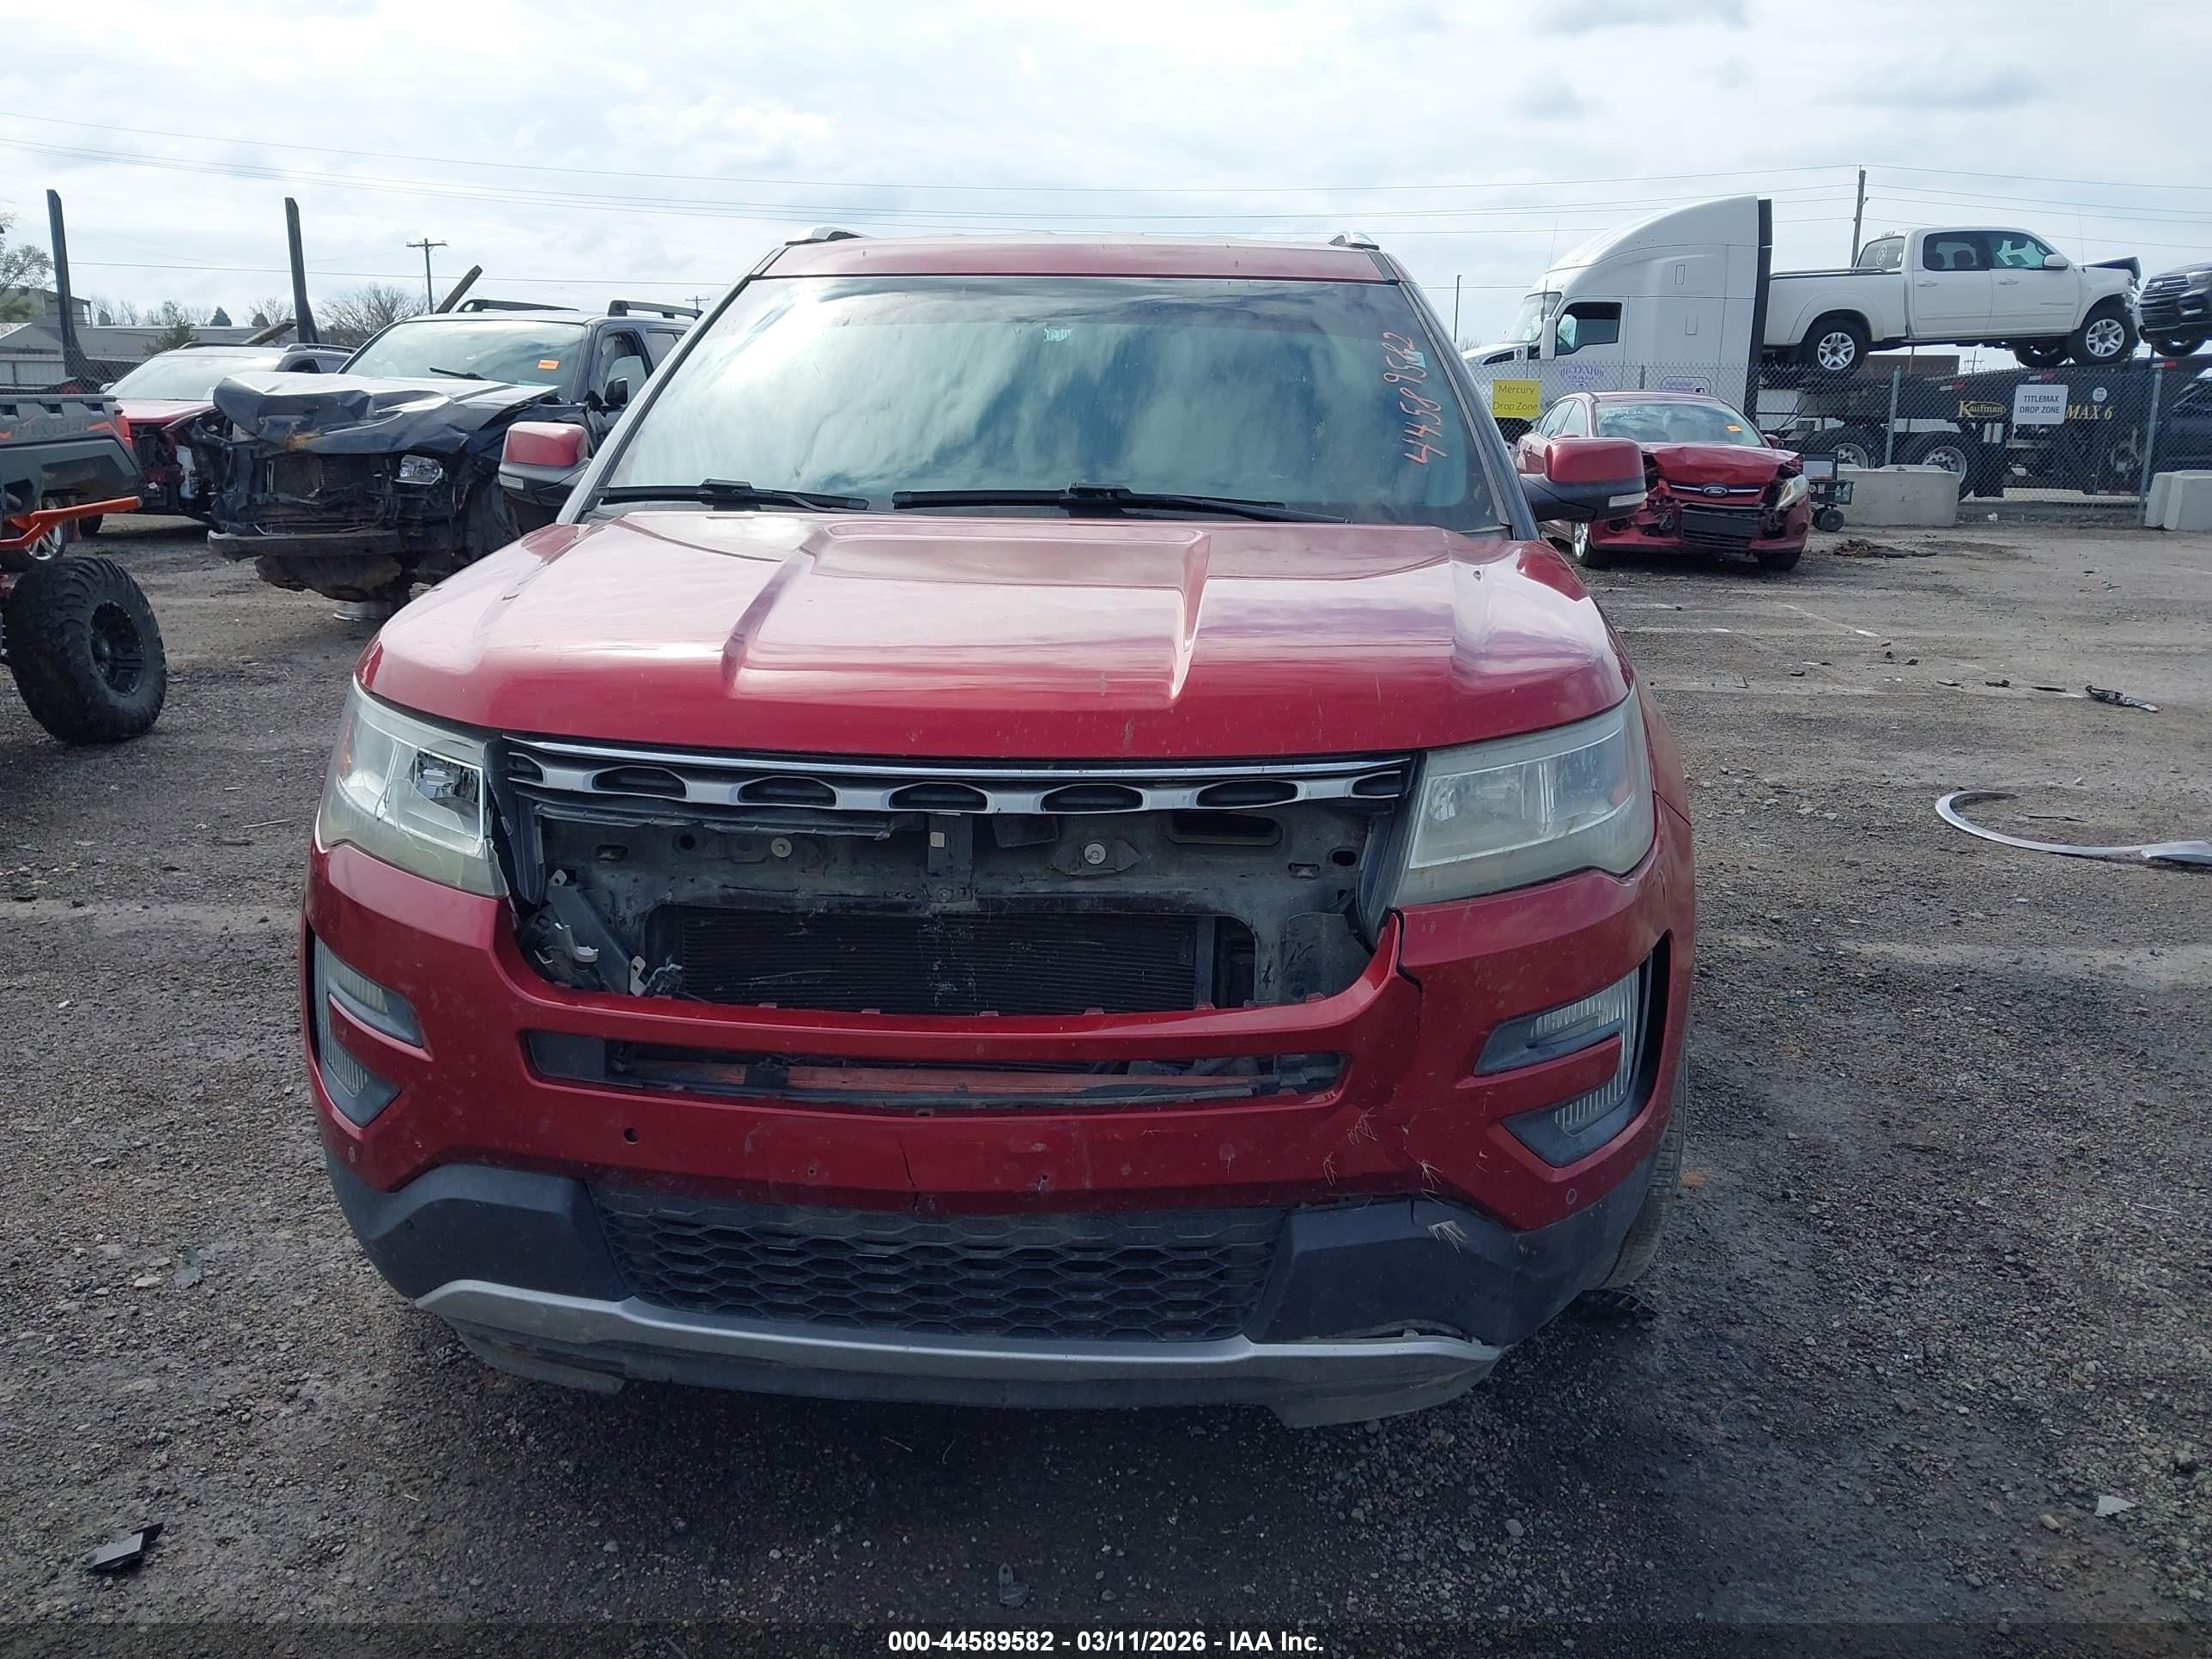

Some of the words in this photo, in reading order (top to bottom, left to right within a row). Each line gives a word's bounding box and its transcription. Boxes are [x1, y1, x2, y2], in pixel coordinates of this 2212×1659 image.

[1498, 385, 1535, 396] Mercury
[1492, 401, 1515, 411] Drop
[1516, 401, 1538, 410] Zone
[1957, 400, 2003, 418] Kaufman
[2041, 405, 2061, 414] ZONE
[2105, 405, 2115, 420] 6
